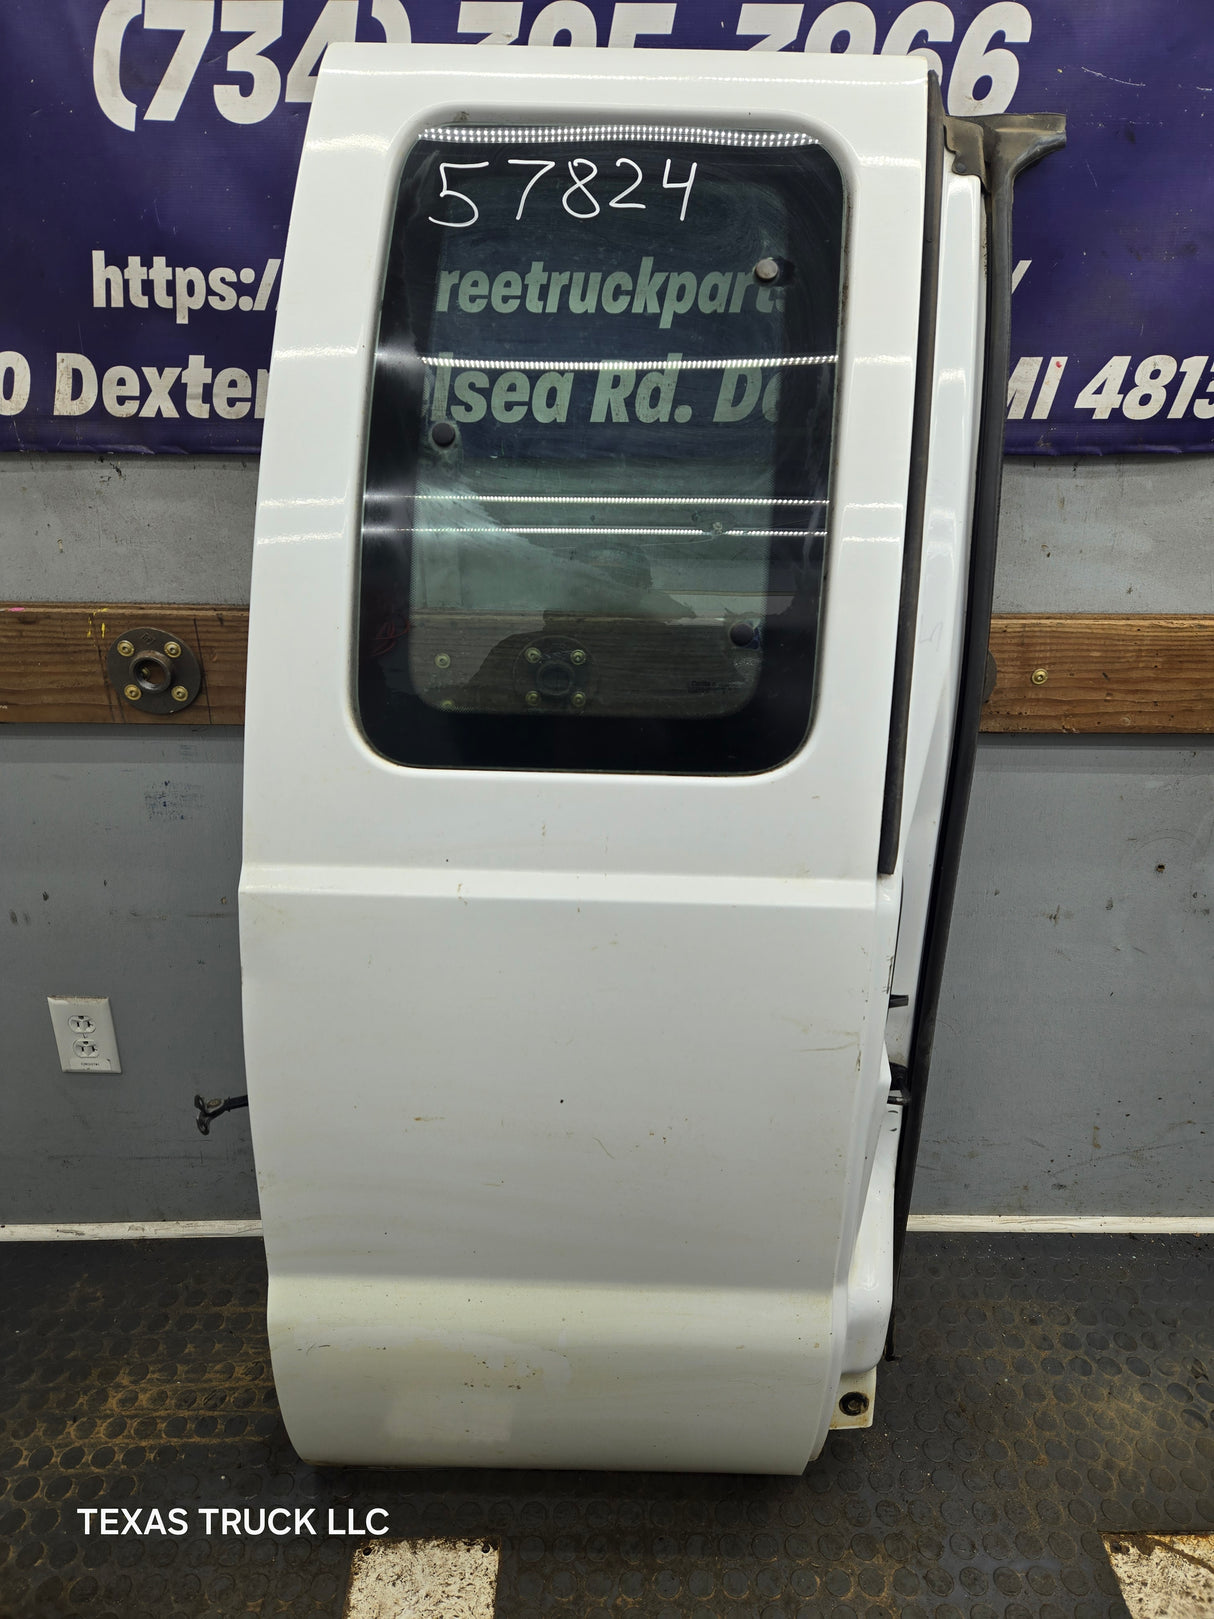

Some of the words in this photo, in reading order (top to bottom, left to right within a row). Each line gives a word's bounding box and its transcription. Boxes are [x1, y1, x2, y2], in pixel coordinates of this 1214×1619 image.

[428, 157, 698, 228] 57824
[91, 250, 282, 325] https:/
[590, 352, 693, 424] Rd.
